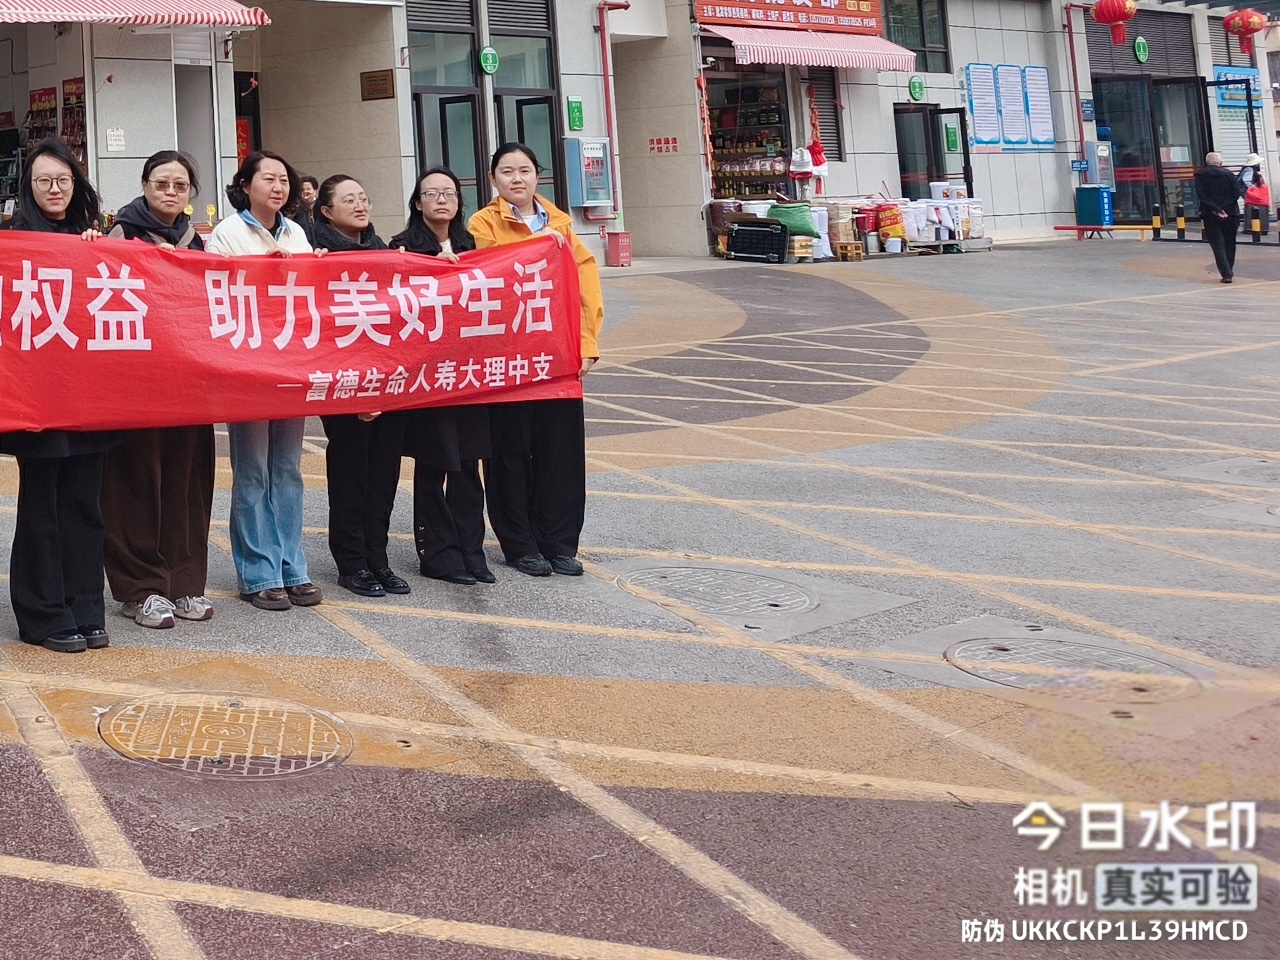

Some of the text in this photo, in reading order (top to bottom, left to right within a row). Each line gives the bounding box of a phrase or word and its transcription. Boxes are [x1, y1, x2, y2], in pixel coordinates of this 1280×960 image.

[486, 53, 493, 64] 3
[204, 258, 554, 350] 助力美好生活
